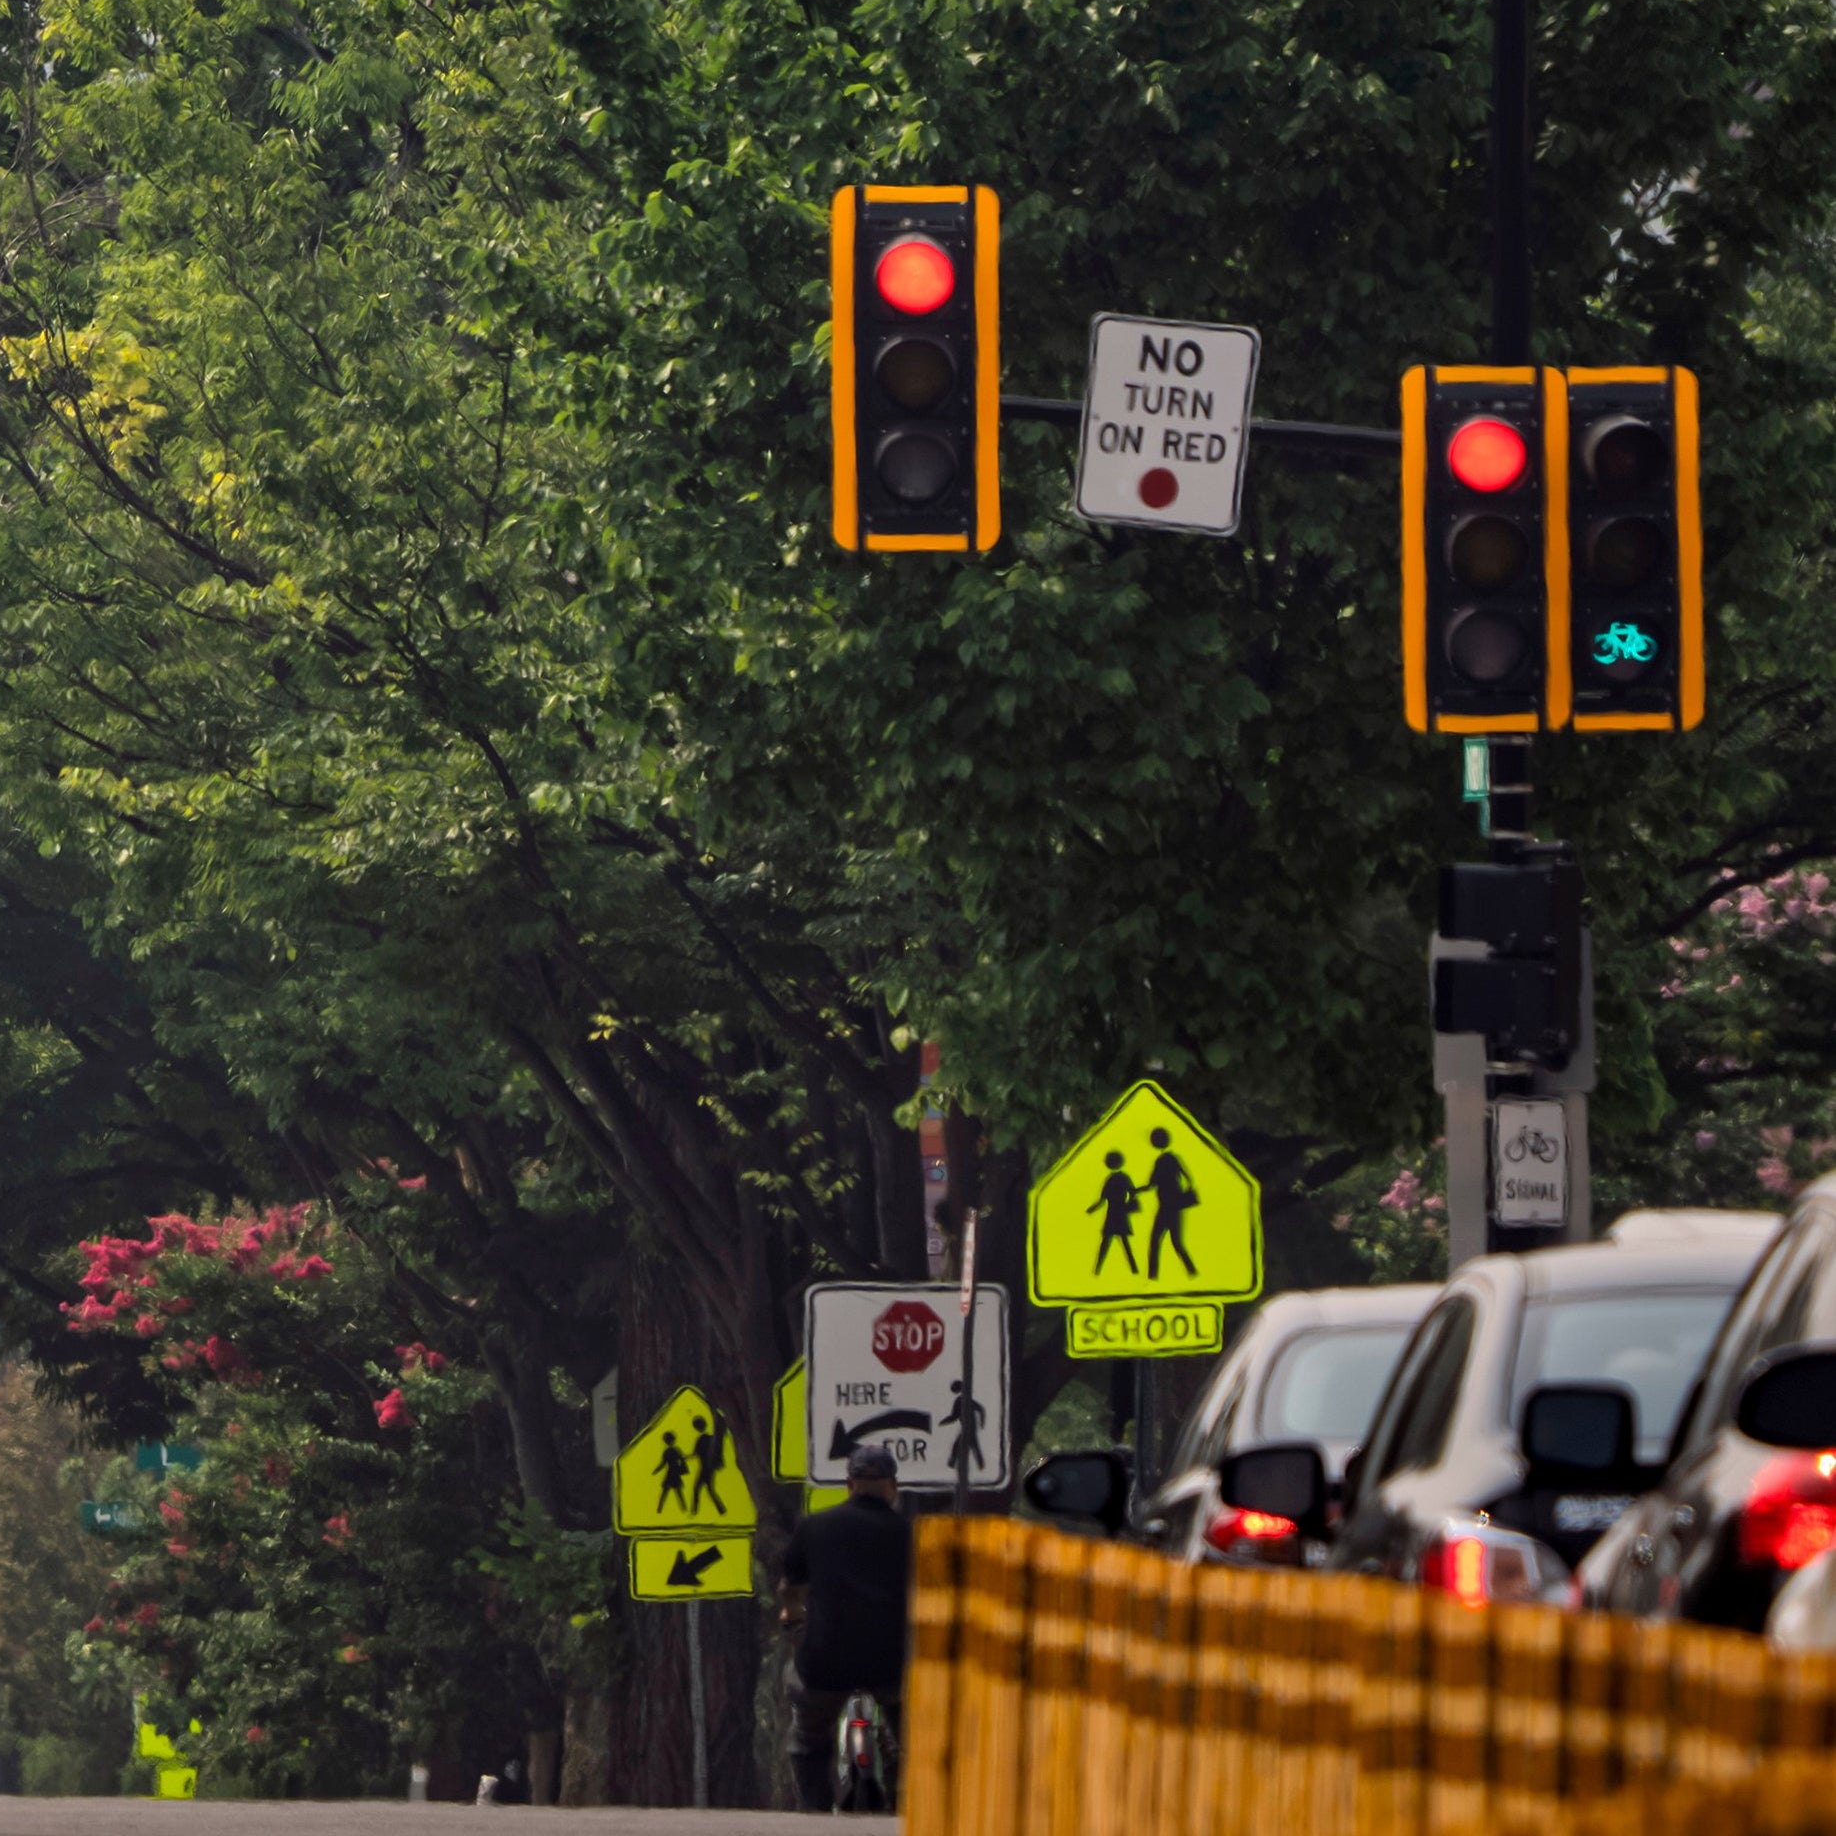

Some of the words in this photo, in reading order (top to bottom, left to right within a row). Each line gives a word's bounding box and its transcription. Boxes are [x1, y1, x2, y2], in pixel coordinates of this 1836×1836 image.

[1139, 334, 1204, 376] NO
[1125, 383, 1213, 420] TURN
[1099, 422, 1144, 454] ON
[1162, 428, 1226, 464] RED
[875, 1322, 942, 1352] STOP
[1081, 1314, 1211, 1344] SCHOOL
[836, 1383, 892, 1406] HERE
